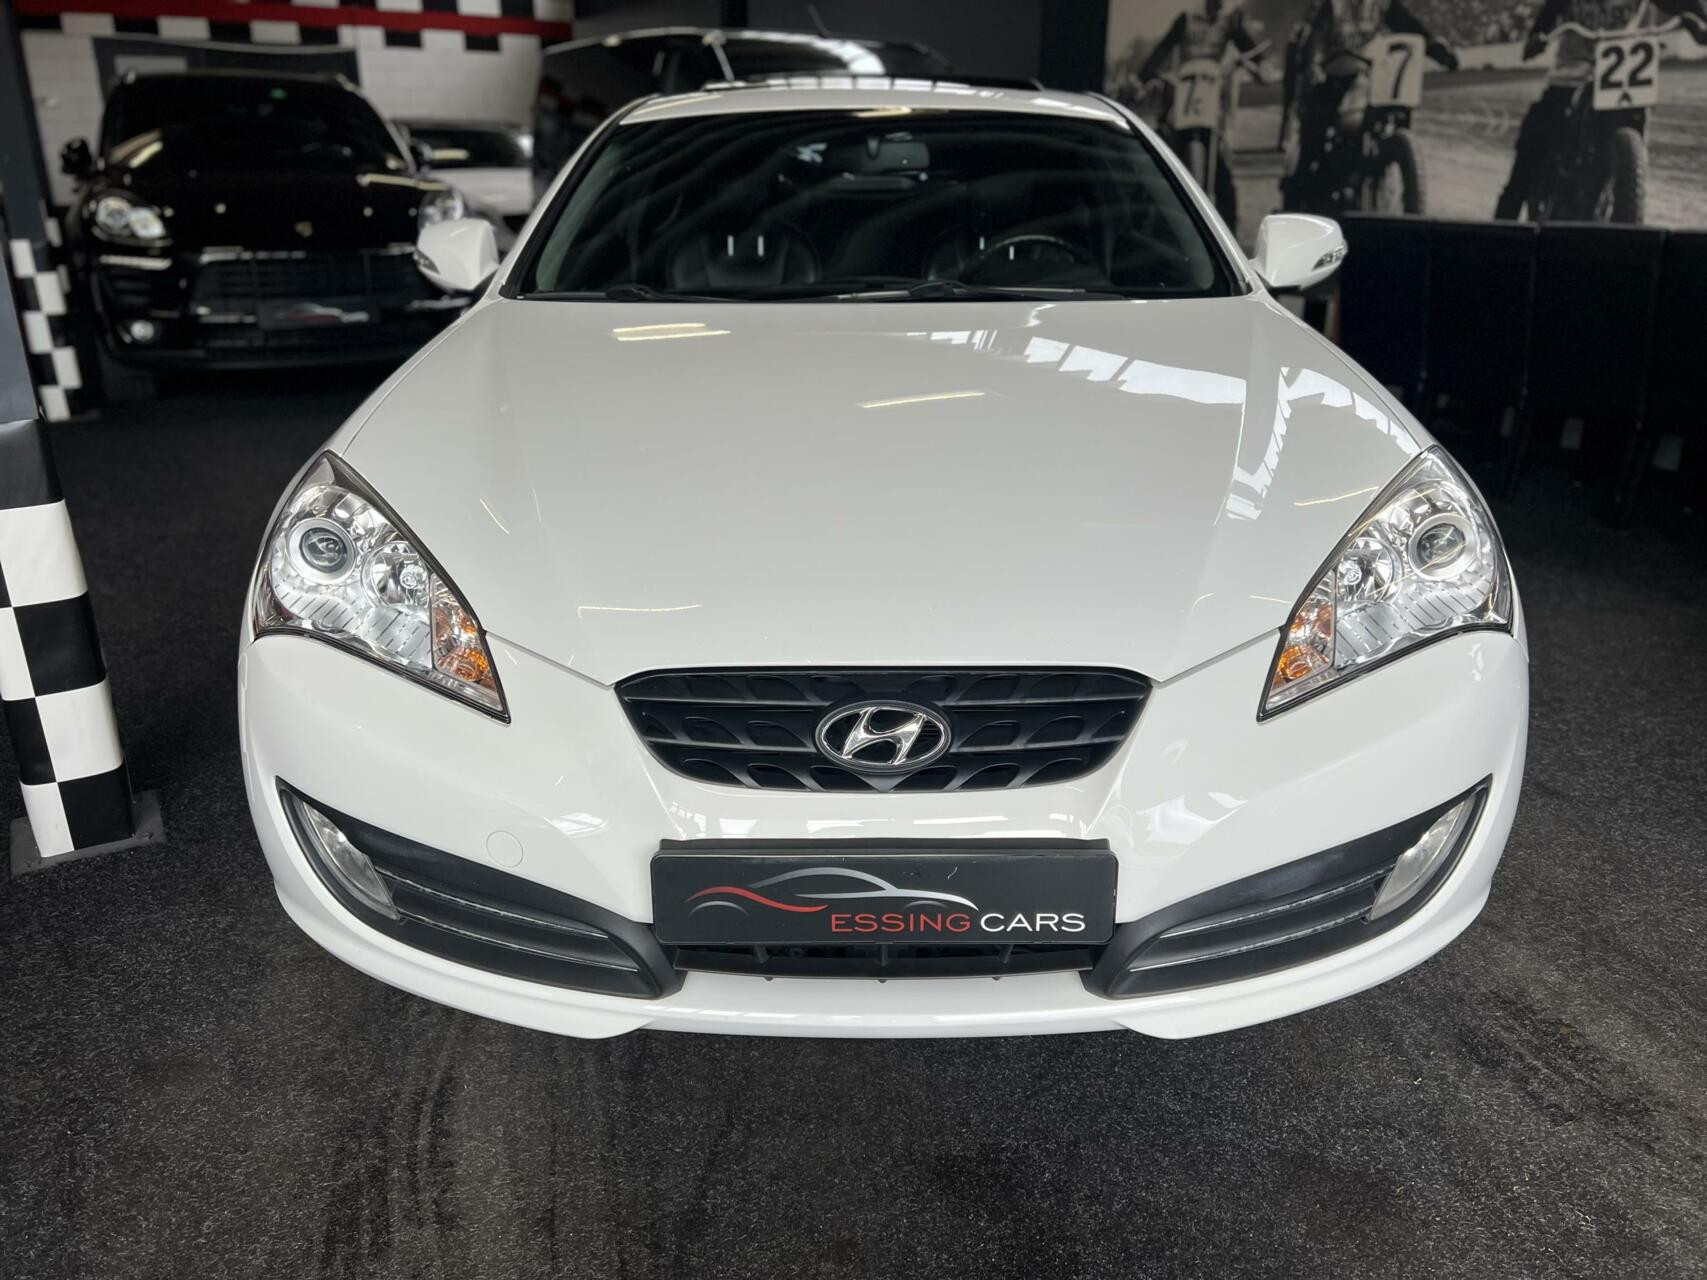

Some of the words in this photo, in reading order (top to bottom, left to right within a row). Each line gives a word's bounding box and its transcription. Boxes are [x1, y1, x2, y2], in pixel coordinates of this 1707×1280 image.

[1388, 43, 1413, 99] 7
[1600, 42, 1654, 90] 22
[831, 913, 972, 933] ESSING
[980, 913, 1086, 932] CARS
